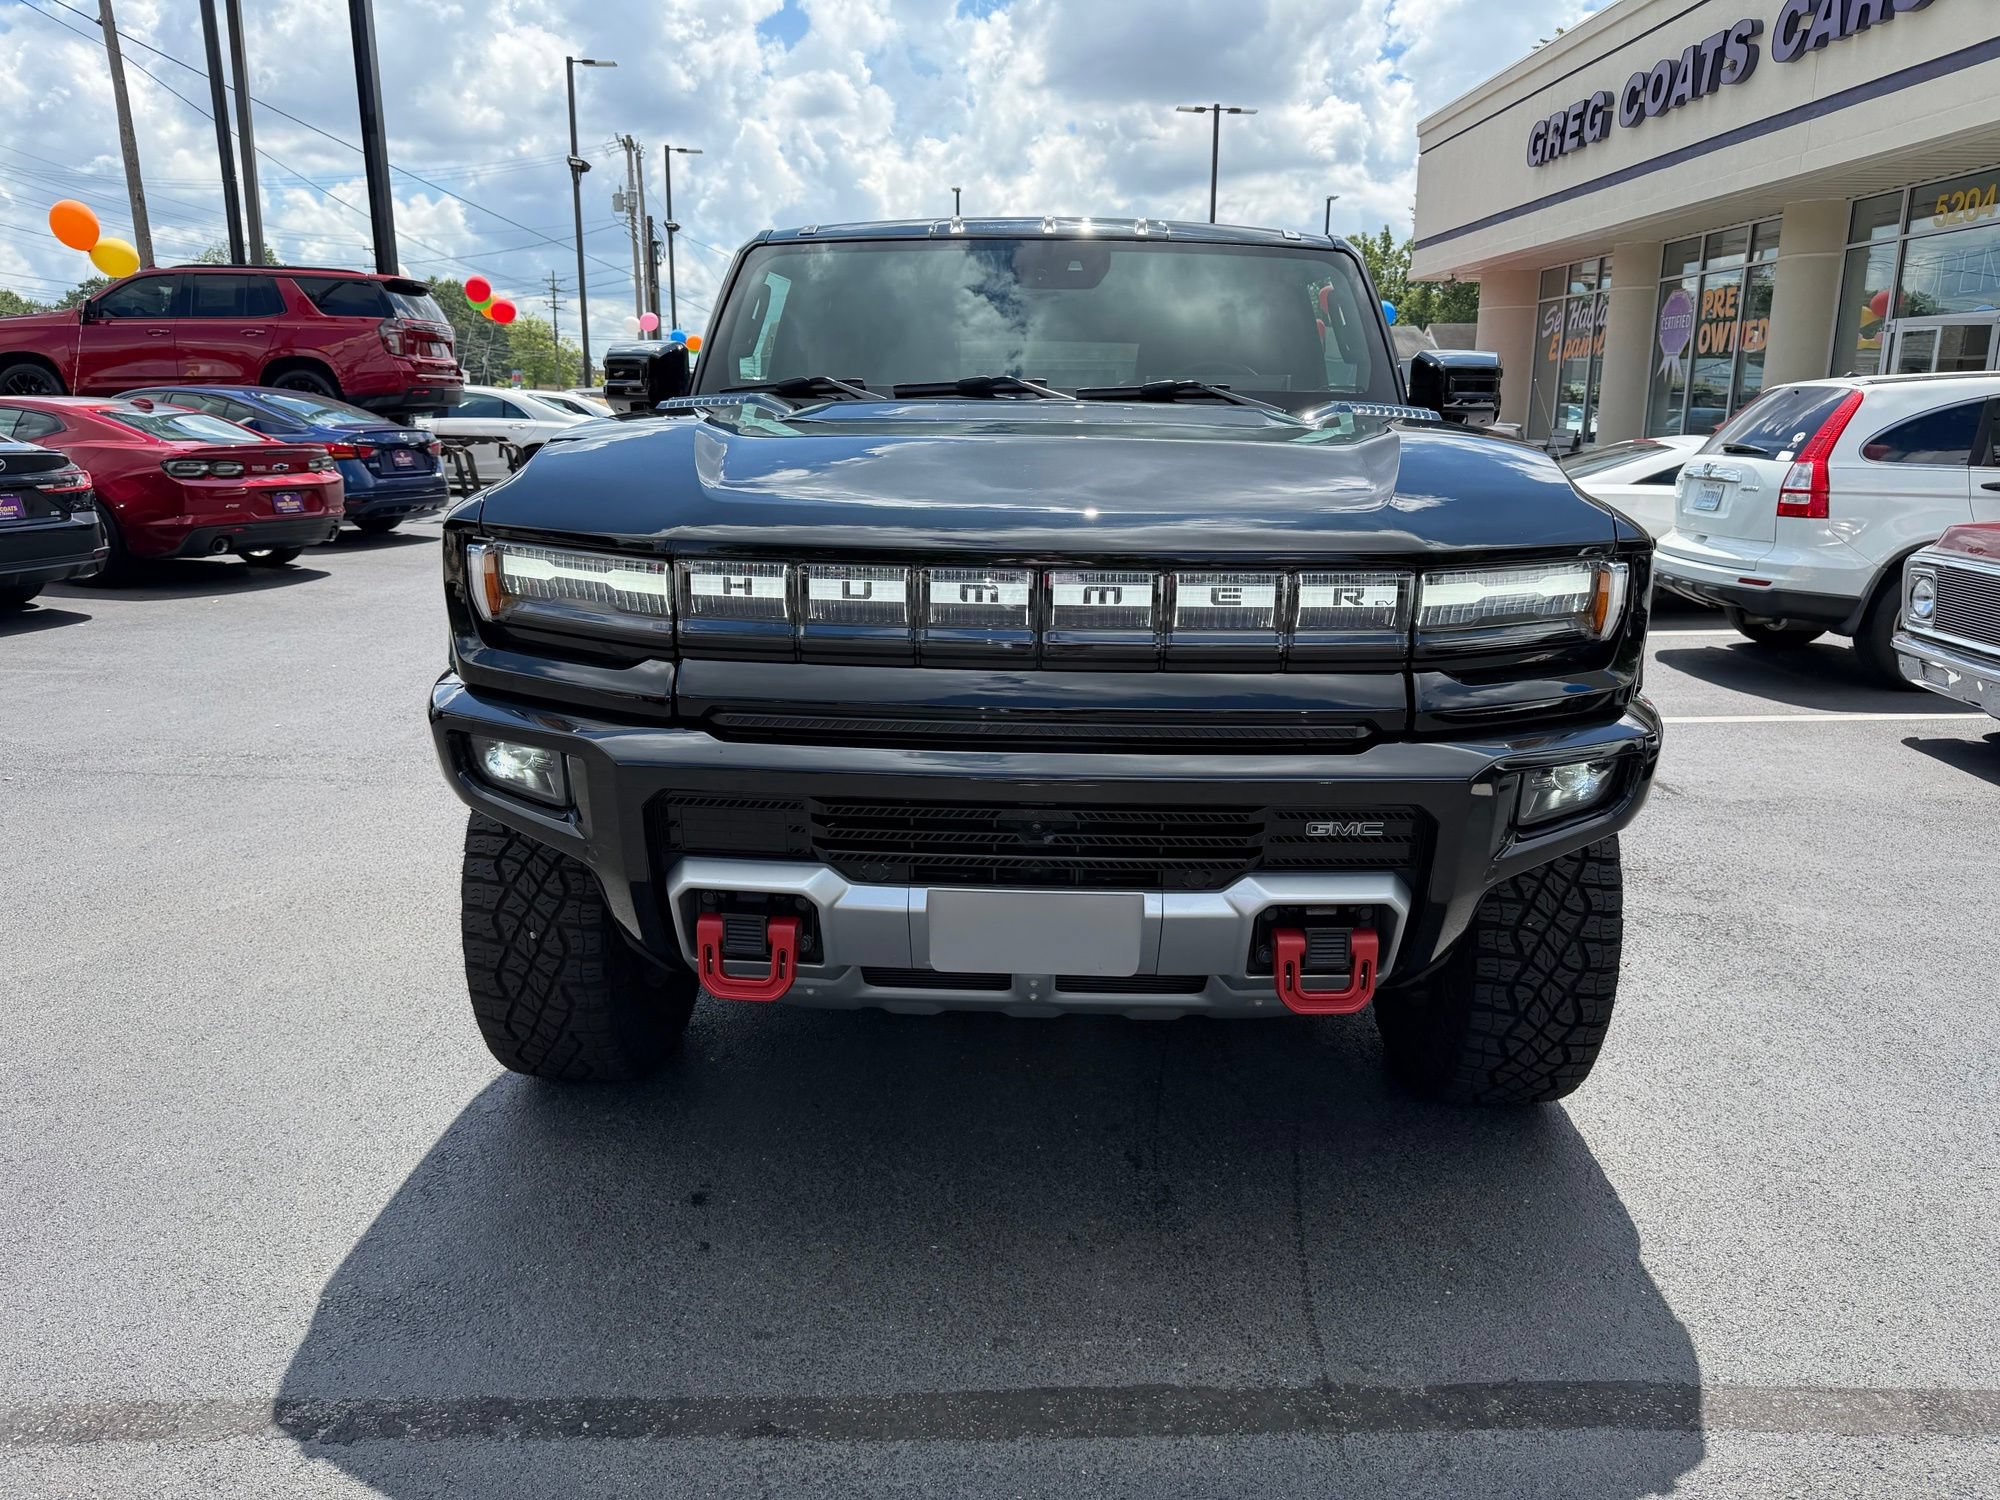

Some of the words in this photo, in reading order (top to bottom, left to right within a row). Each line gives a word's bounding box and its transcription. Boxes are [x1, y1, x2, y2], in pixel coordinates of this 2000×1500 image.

[1527, 91, 1613, 167] GREG
[1619, 19, 1764, 128] COATS
[1772, 0, 1934, 63] CA
[1933, 183, 1997, 227] 5204
[1542, 305, 1562, 338] Se
[1660, 314, 1691, 330] CERTIFIED
[1698, 318, 1770, 354] OWNED
[723, 576, 1364, 606] HUMMER
[1306, 822, 1384, 836] GMC
